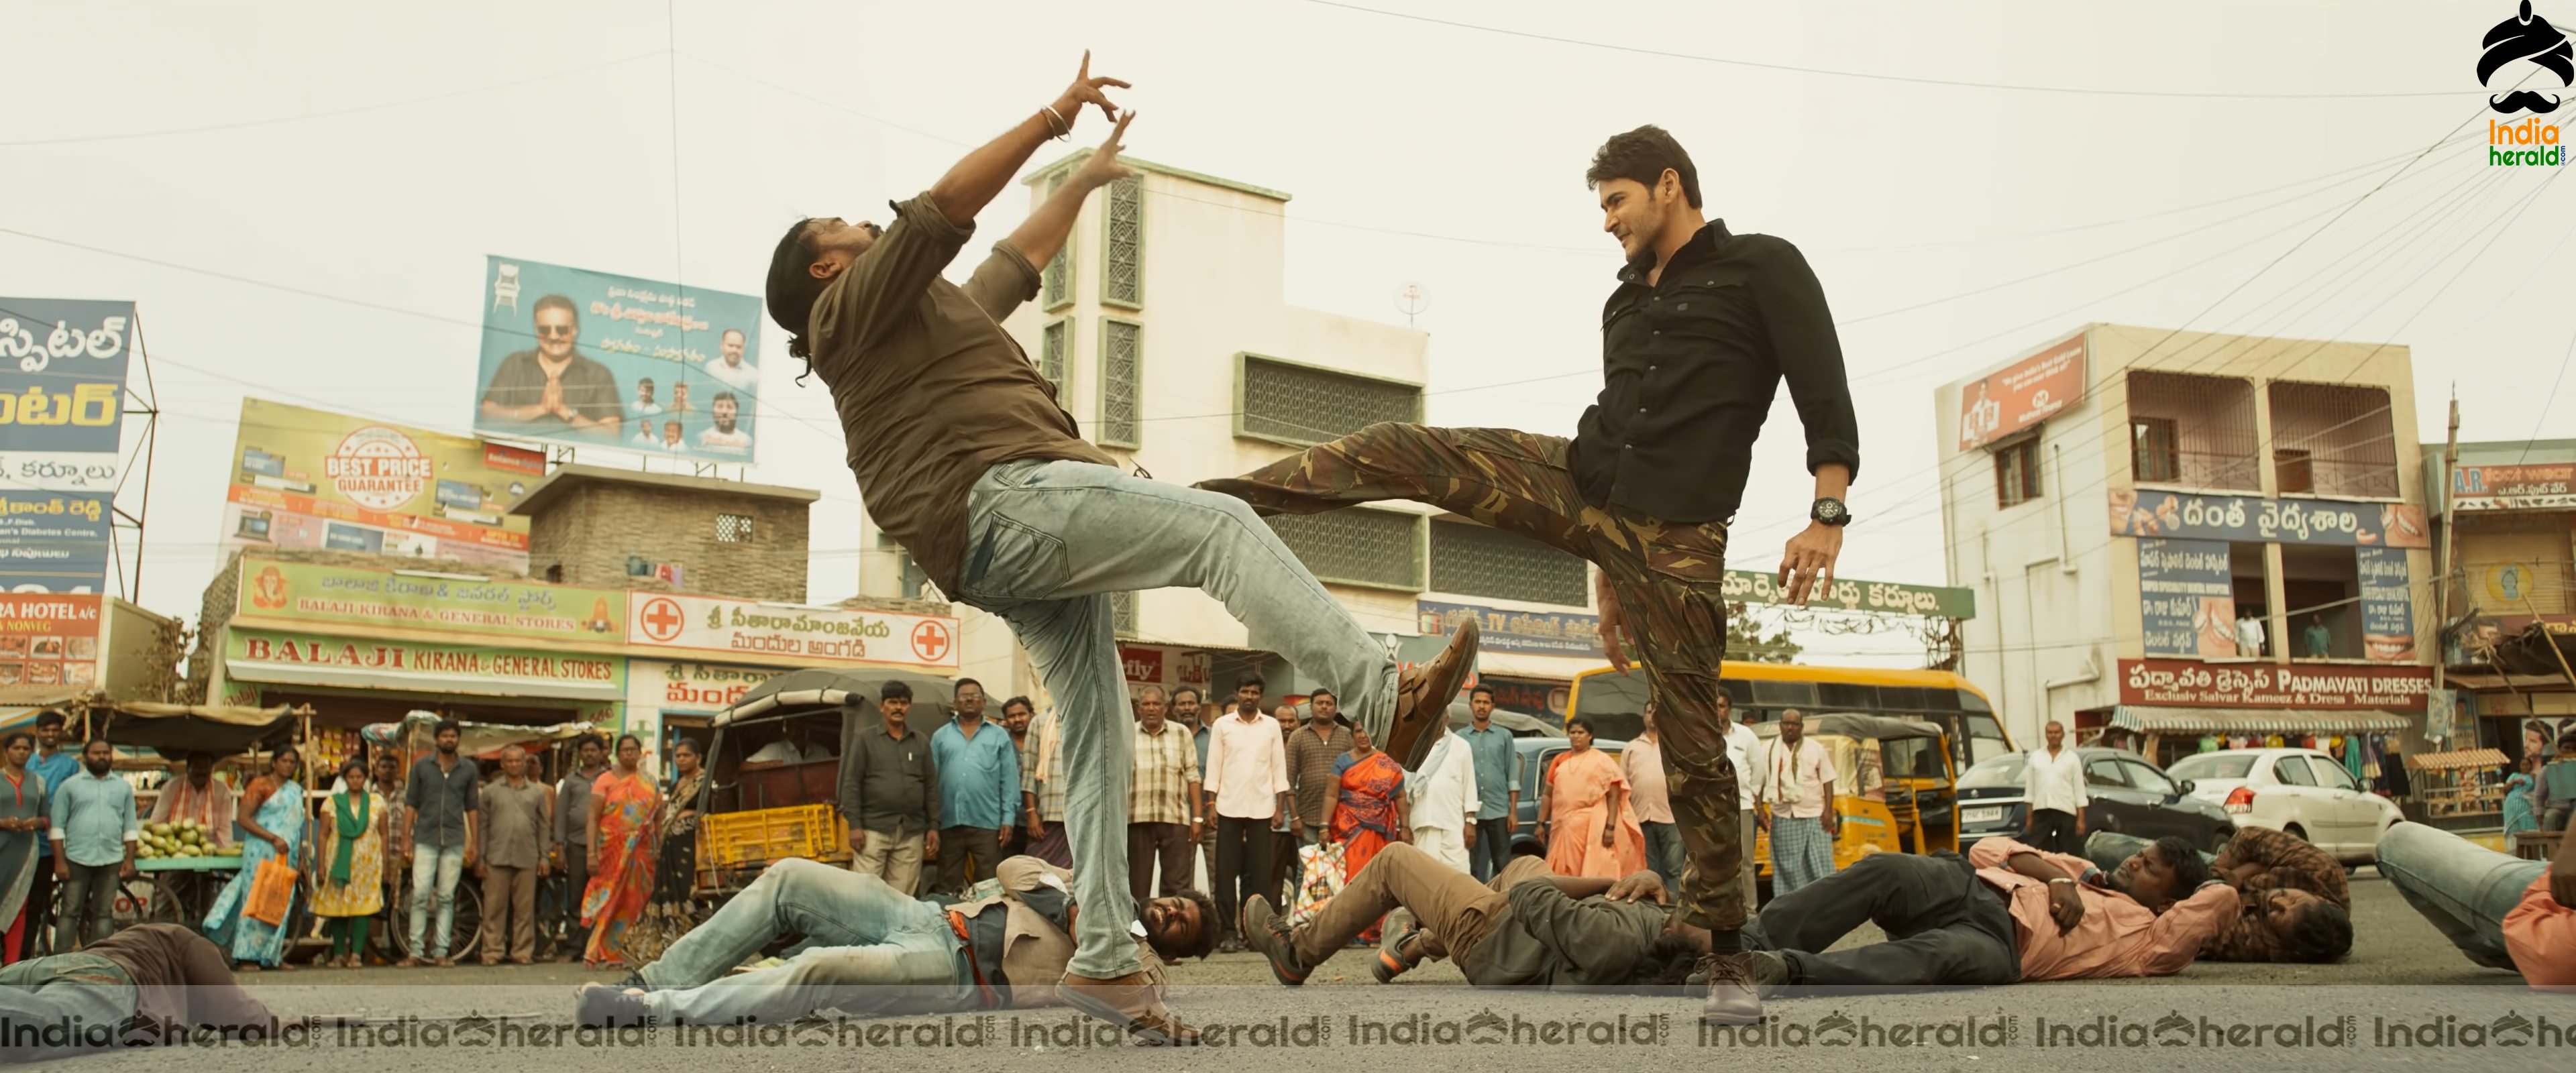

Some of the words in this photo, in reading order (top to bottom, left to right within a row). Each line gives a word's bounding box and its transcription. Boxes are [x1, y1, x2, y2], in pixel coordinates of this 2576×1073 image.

[327, 457, 372, 477] BEST
[378, 457, 431, 477] PRICE
[337, 479, 421, 493] GUARANTEE
[2184, 498, 2245, 528] దంత
[2257, 500, 2357, 541] వైద్యశాల
[21, 527, 62, 536] Diabetes
[21, 602, 77, 620] HOTEL
[299, 598, 354, 614] BALAJI
[360, 604, 419, 619] KIRANA
[423, 608, 434, 620] &
[439, 610, 511, 626] GENERAL
[515, 616, 575, 630] STORES
[7, 620, 52, 632] NONVEG
[707, 605, 722, 630] శ్రీ
[731, 606, 890, 638] సీతారామాంజనేయ
[1487, 613, 1506, 632] TV
[731, 631, 801, 653] మందుల
[808, 638, 865, 658] అంగడి
[246, 638, 405, 669] BALAJI
[413, 651, 478, 674] KIRANA
[493, 655, 557, 678] GENERAL
[561, 659, 612, 680] STORES
[2129, 663, 2212, 692] పద్మావతి
[2372, 677, 2433, 695] DRESSES
[2144, 689, 2197, 702] Exclusiv
[2200, 691, 2239, 703] Salvar
[2242, 692, 2292, 704] Kameez
[2294, 693, 2306, 703] &
[2310, 693, 2346, 704] Dress
[2354, 693, 2410, 705] Materials
